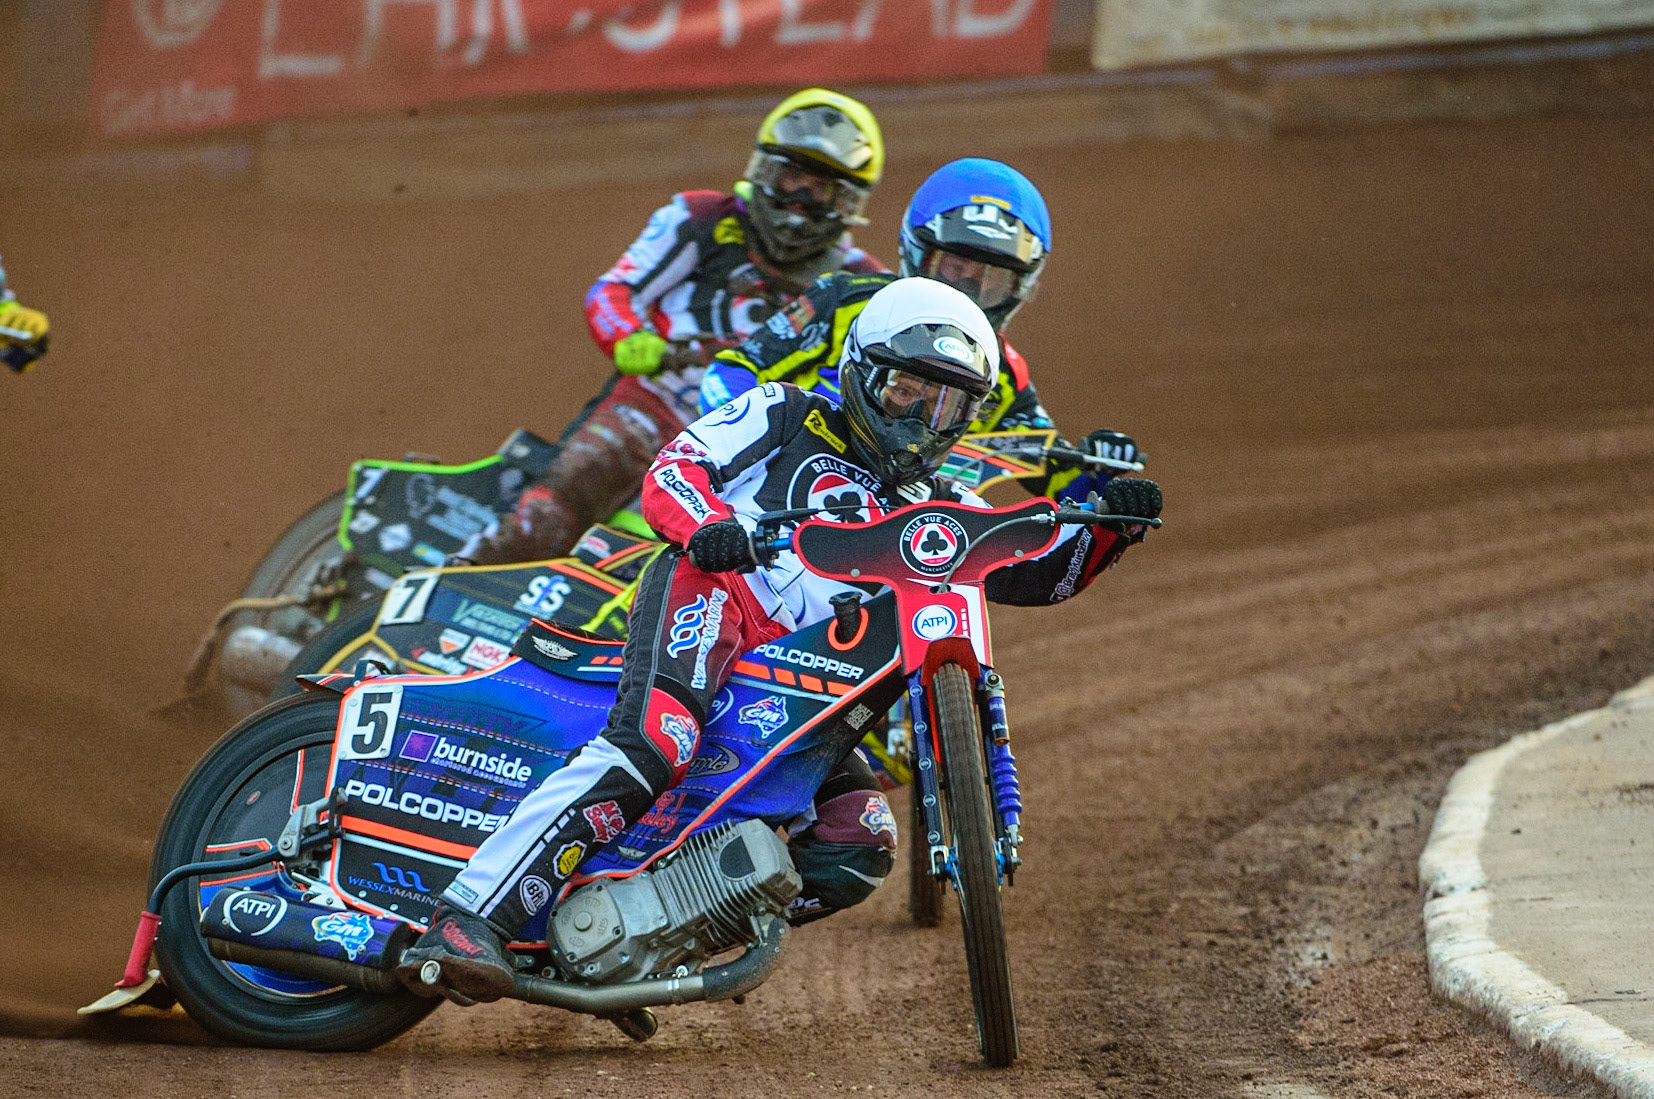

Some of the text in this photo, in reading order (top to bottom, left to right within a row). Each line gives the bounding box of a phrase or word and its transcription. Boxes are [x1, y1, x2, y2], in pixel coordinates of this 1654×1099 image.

[810, 459, 847, 476] BELLE
[853, 471, 882, 493] VUE
[903, 520, 923, 542] BELLE
[943, 520, 963, 537] ACES
[394, 576, 432, 620] 7
[920, 615, 948, 630] ATPI
[752, 644, 864, 680] POLCOPPER
[351, 691, 394, 754] 5
[745, 708, 783, 724] GM
[667, 720, 694, 754] GM
[433, 737, 532, 782] burnside
[232, 897, 276, 919] ATPI
[320, 920, 364, 937] GM
